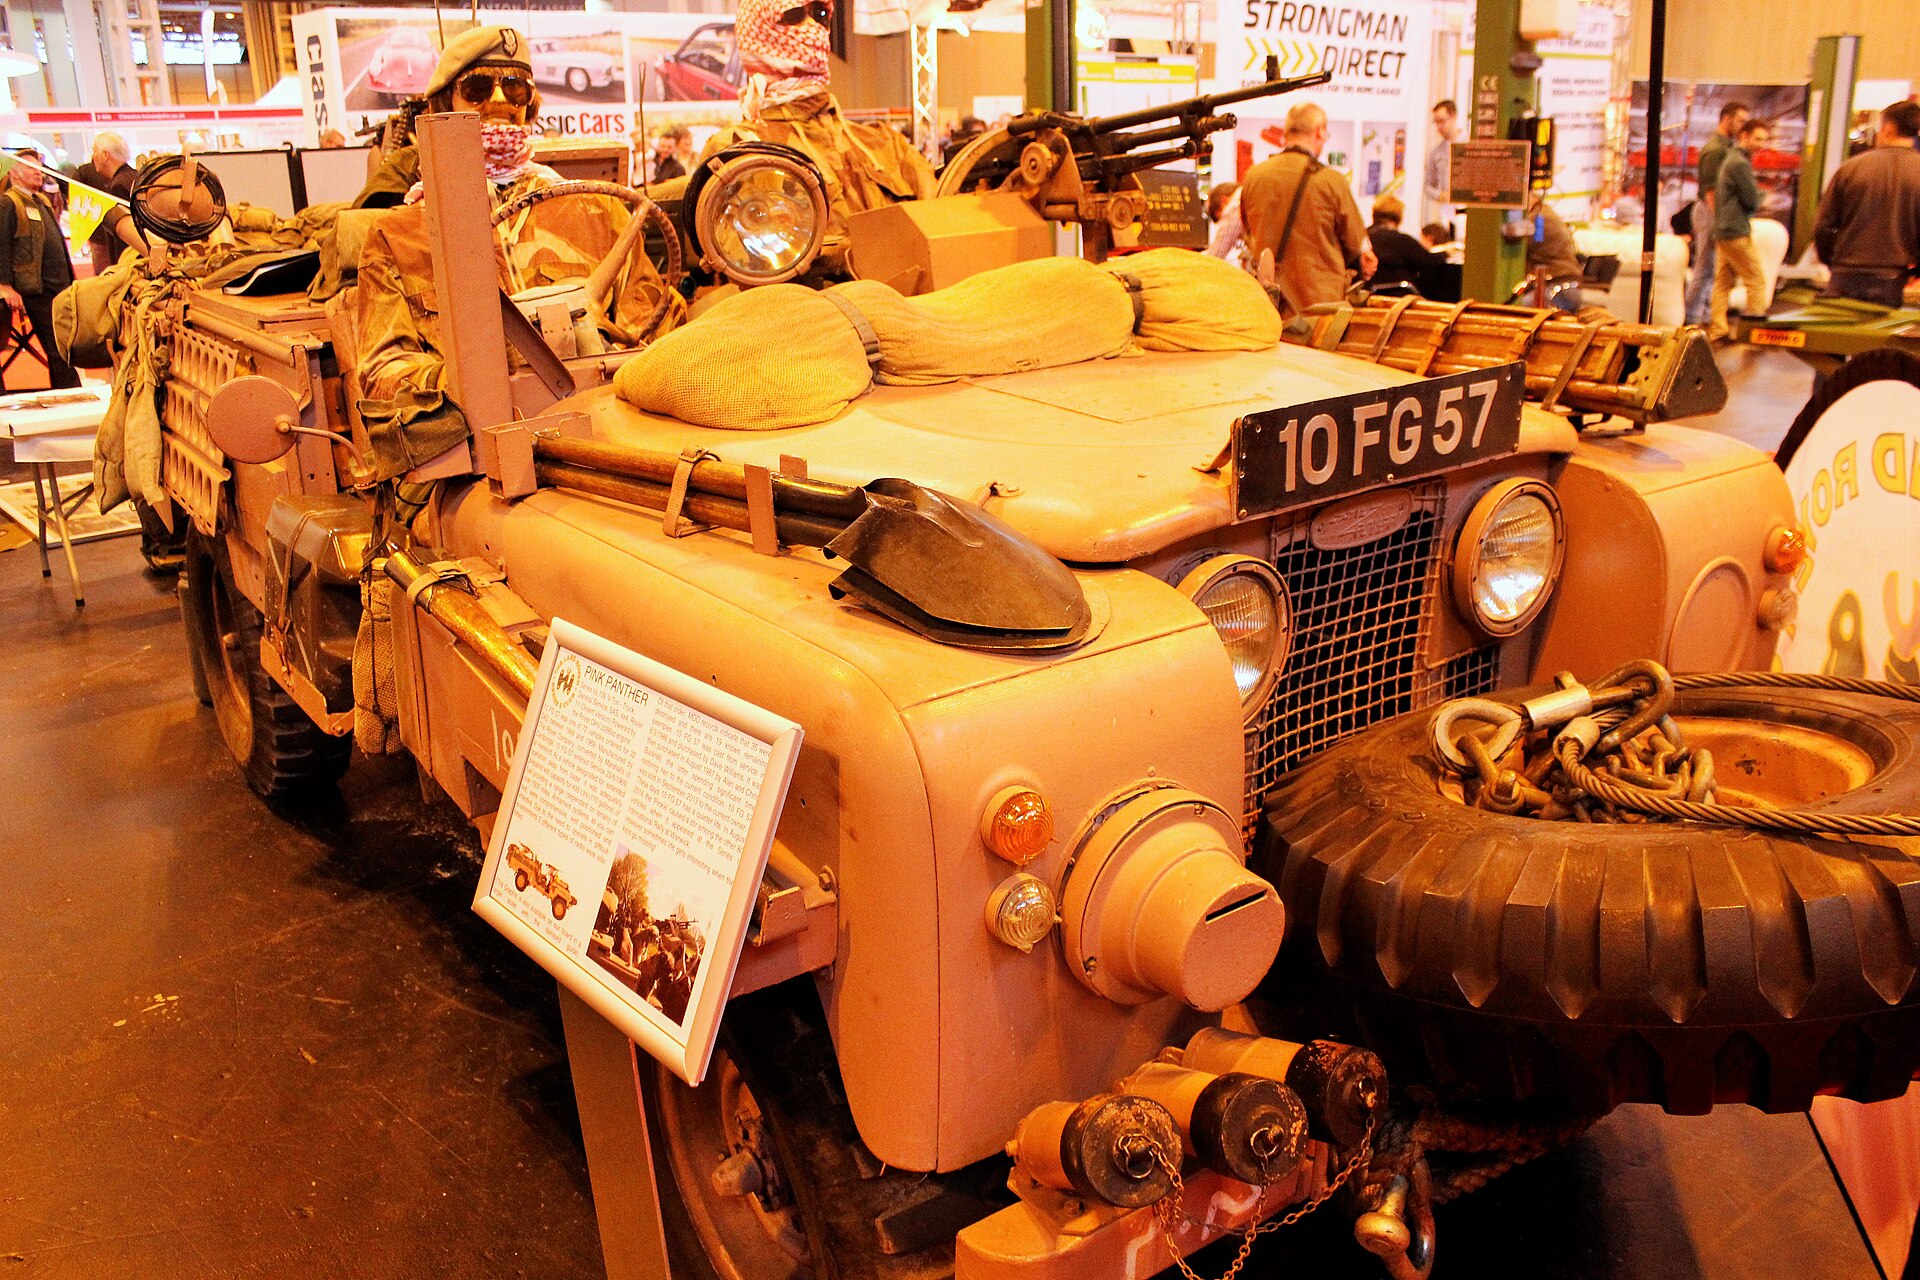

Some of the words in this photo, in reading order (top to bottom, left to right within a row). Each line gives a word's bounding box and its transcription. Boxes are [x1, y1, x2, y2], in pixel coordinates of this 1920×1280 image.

[1244, 0, 1408, 43] STRONGMAN
[1321, 45, 1407, 80] DIRECT
[579, 112, 625, 135] Cars
[1279, 414, 1338, 493] 10
[1352, 396, 1423, 477] FG
[1432, 379, 1499, 456] 57
[584, 665, 606, 686] PINK
[605, 675, 649, 707] PANTHER
